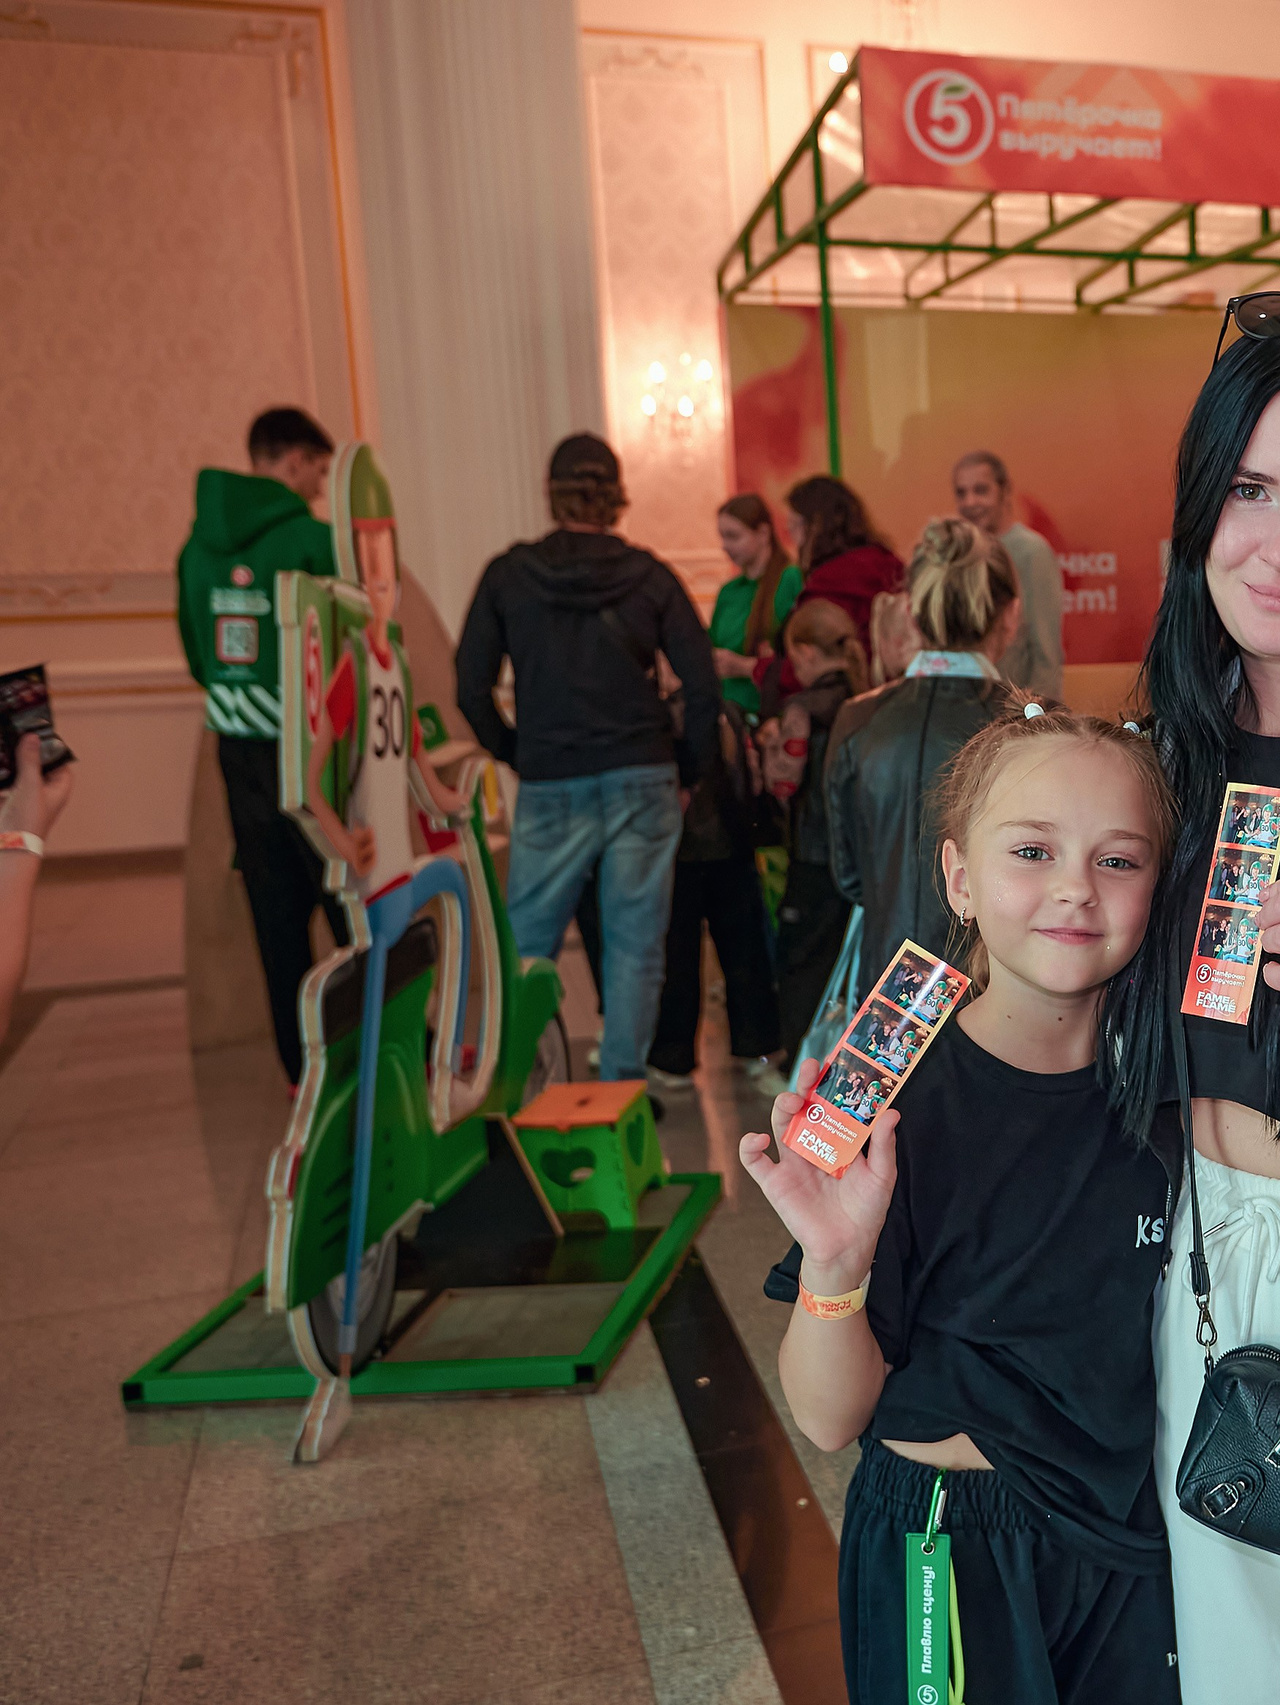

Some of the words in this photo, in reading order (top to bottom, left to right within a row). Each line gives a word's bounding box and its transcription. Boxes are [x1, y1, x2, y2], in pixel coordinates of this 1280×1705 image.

[373, 685, 405, 758] 30
[1196, 998, 1236, 1013] FLAME
[1197, 991, 1231, 1004] FAME
[796, 1135, 838, 1165] FLAME
[800, 1128, 835, 1154] FAME
[921, 1565, 936, 1614] сцену!
[920, 1617, 932, 1674] Плавлю
